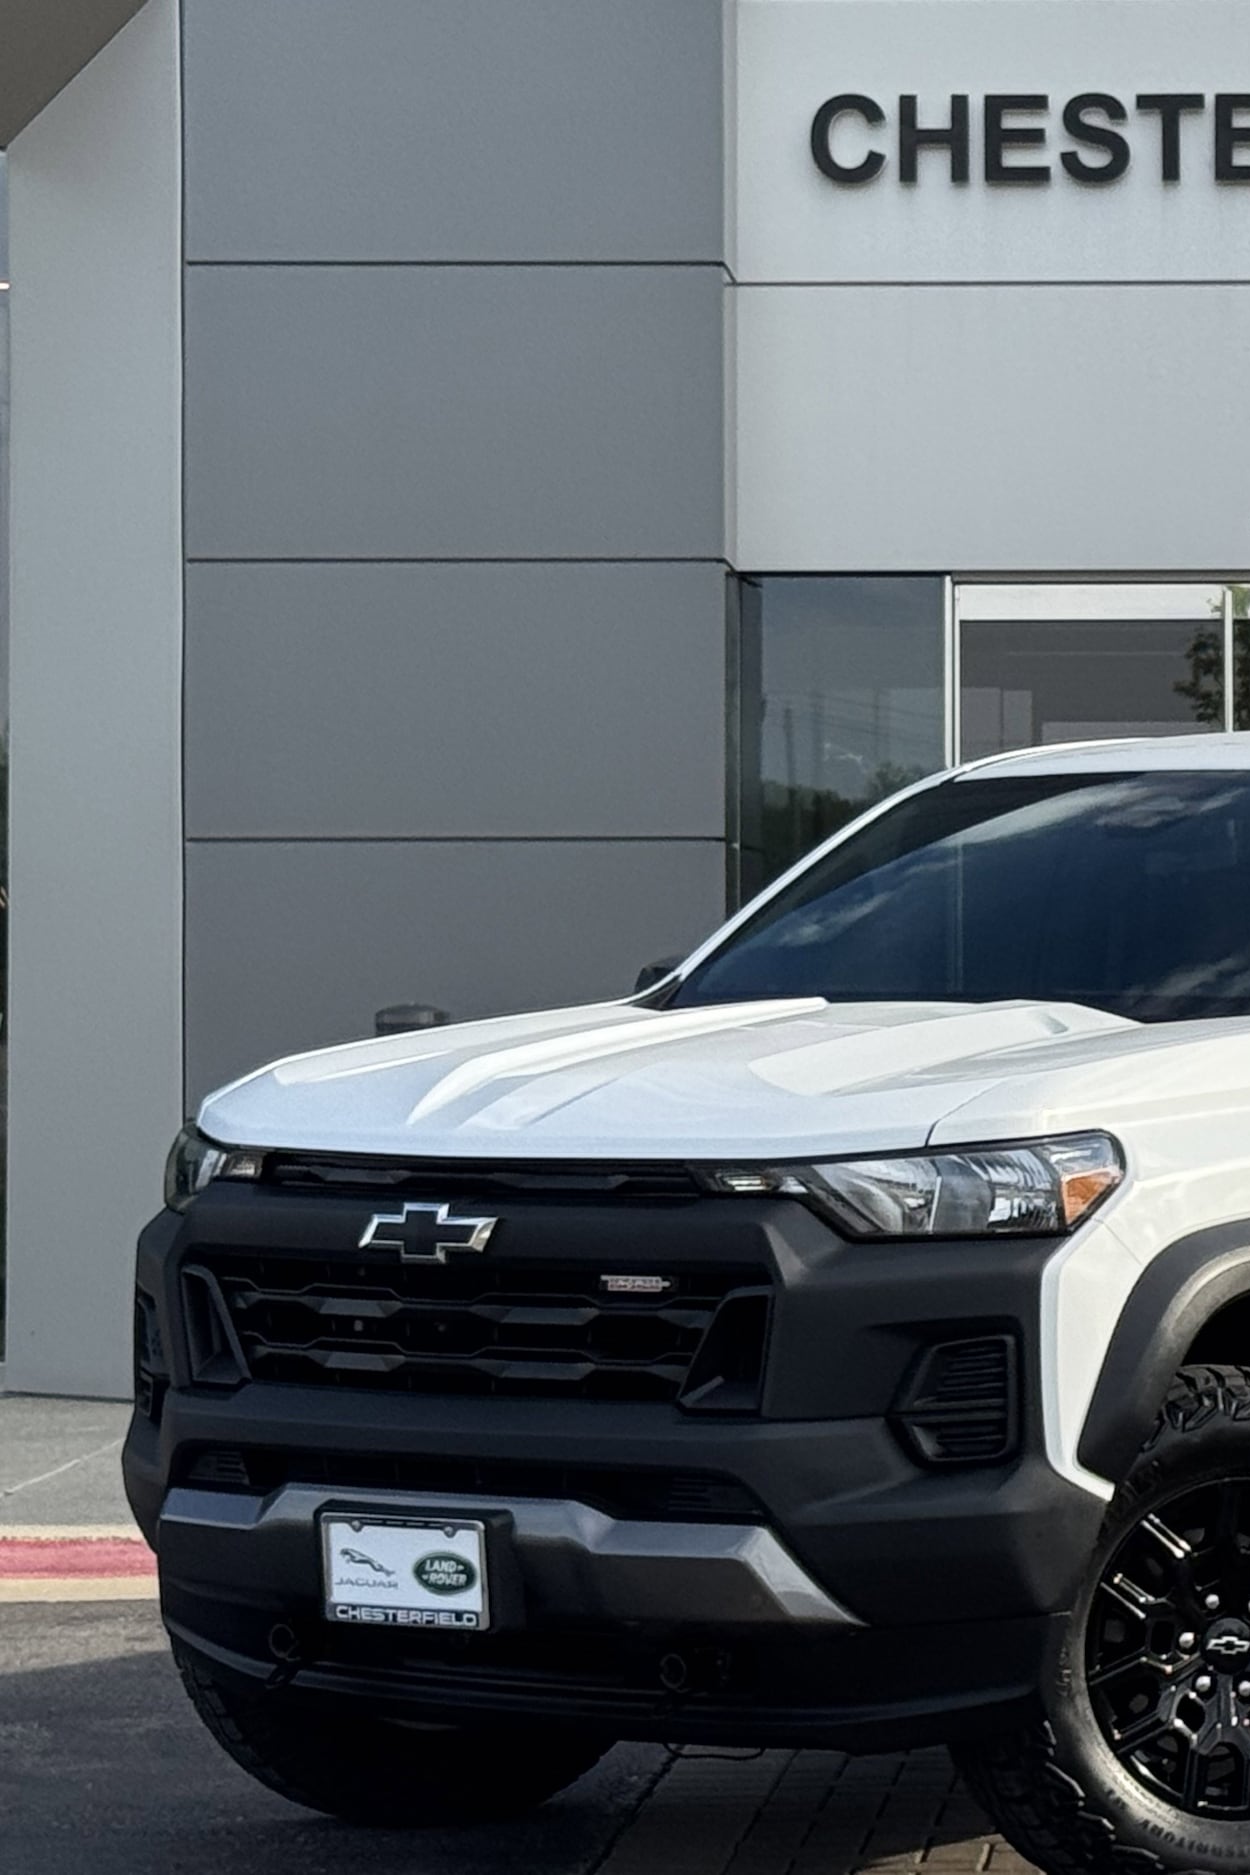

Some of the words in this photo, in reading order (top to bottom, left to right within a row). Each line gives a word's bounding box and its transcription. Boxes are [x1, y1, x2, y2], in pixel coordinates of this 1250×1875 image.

[425, 1559, 455, 1572] LAND
[335, 1576, 399, 1590] JAGUAR
[428, 1571, 468, 1586] ROVER
[335, 1604, 478, 1627] CHESTERFIELD
